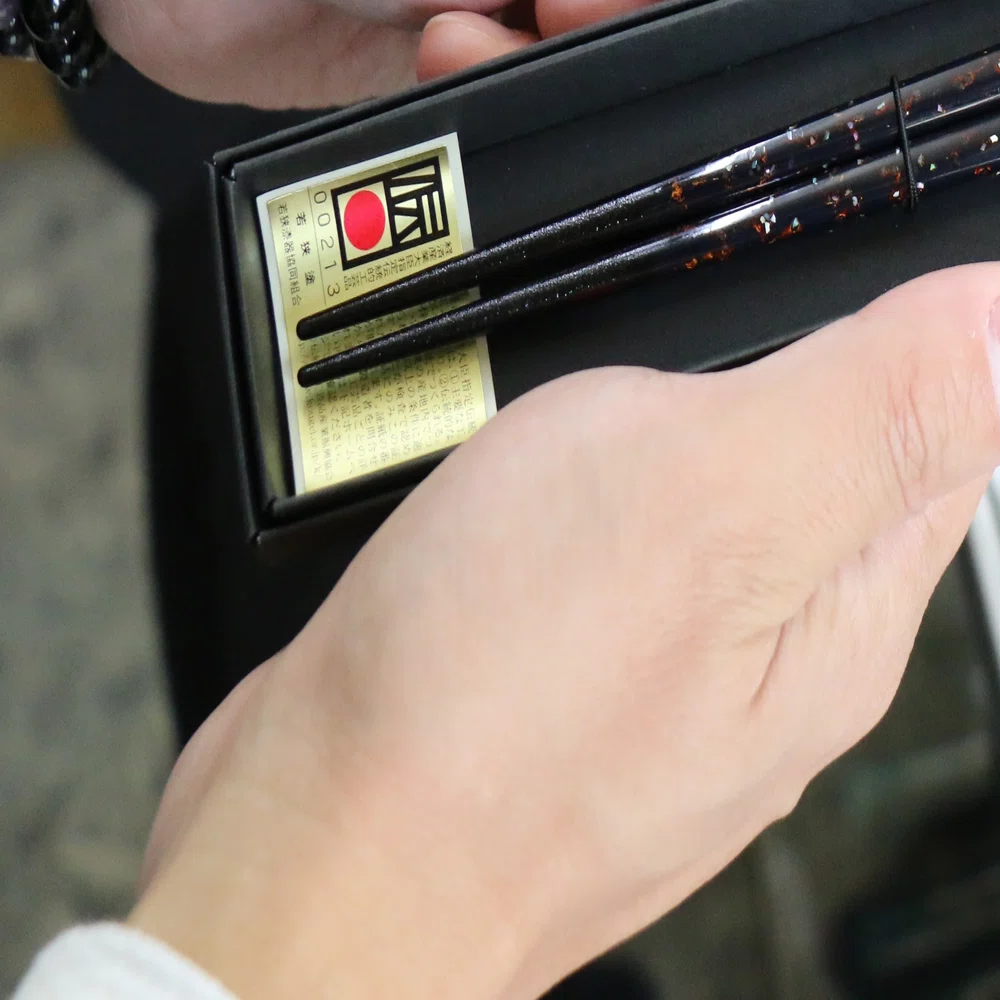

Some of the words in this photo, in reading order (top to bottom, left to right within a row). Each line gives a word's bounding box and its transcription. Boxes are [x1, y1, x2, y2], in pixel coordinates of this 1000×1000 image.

[277, 201, 302, 308] 若狭漆器協同組合
[295, 210, 316, 286] 若狭塗
[313, 189, 341, 298] 00213
[456, 342, 477, 434] 大臣指定伝統
